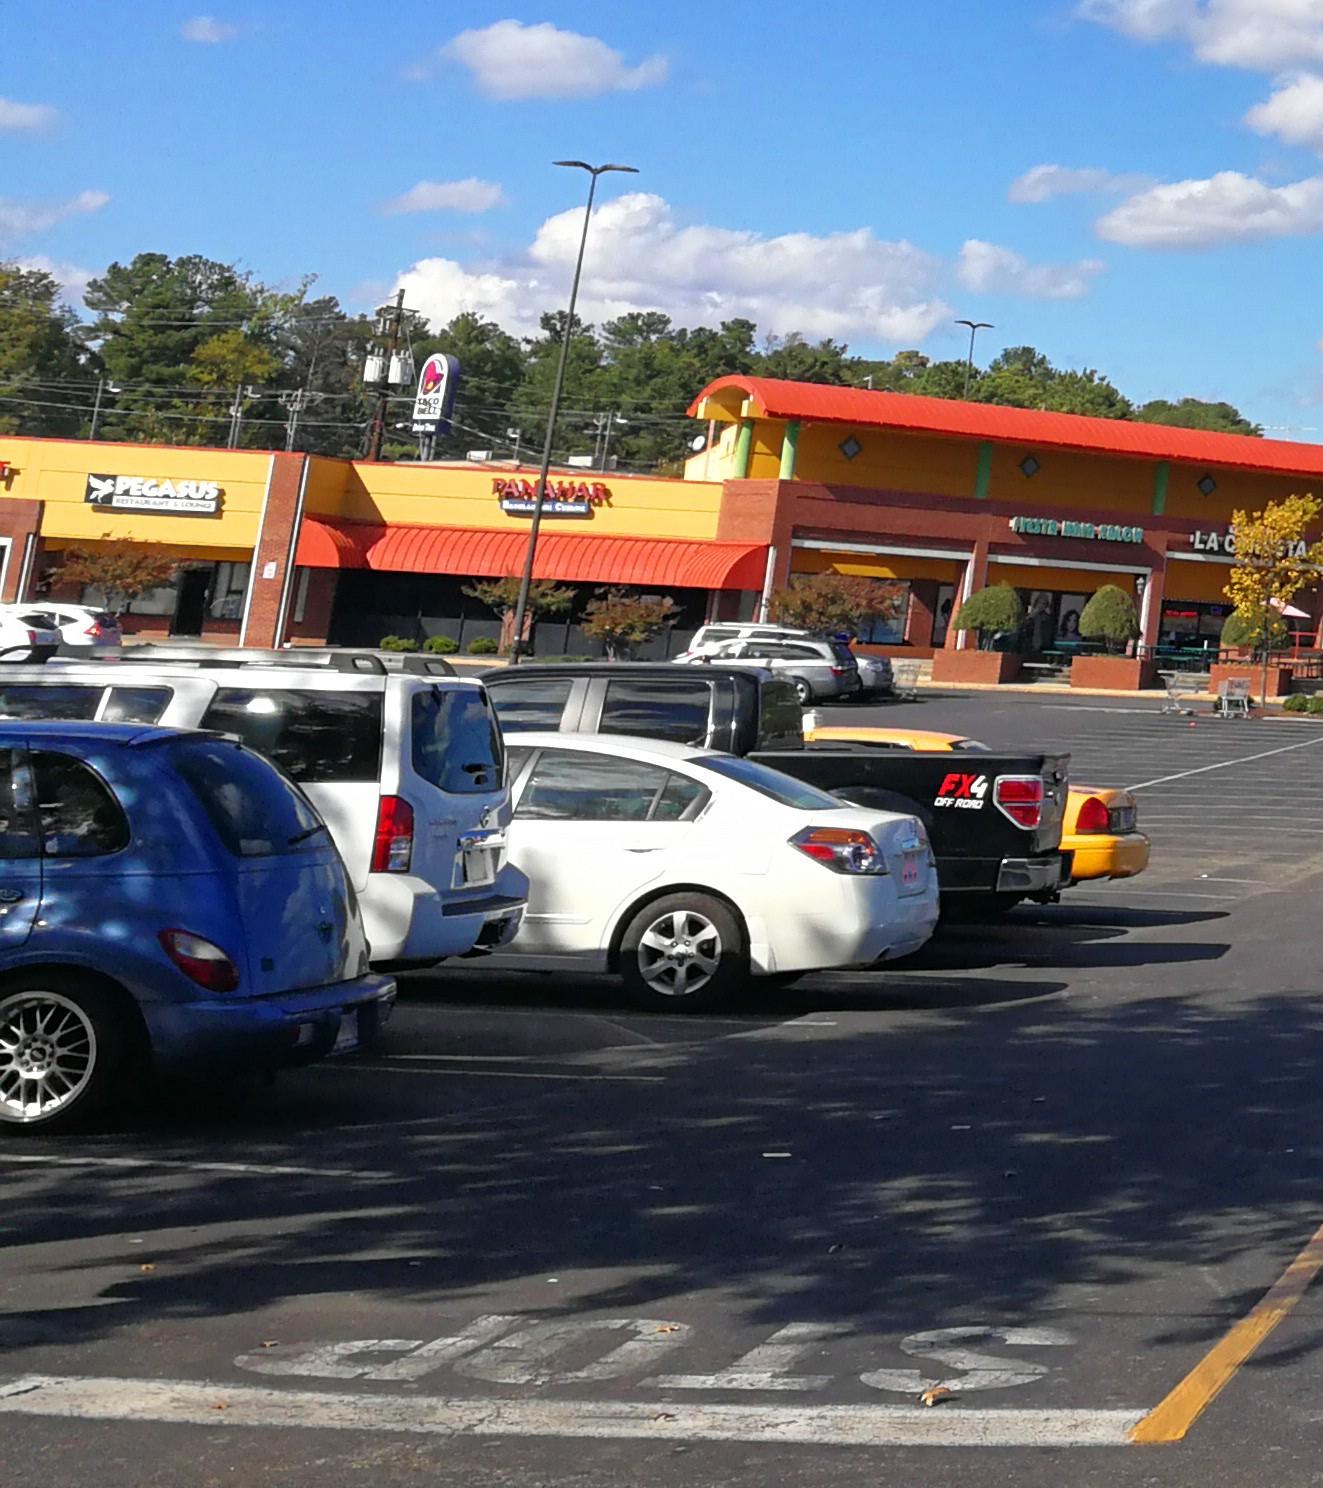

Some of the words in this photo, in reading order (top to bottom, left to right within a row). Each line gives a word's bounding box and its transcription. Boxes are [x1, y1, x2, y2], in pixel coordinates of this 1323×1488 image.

[417, 397, 440, 407] TACO
[115, 475, 219, 500] PEGASUS
[1193, 530, 1219, 551] LA
[938, 773, 988, 798] FX4
[934, 797, 955, 807] OFF
[954, 798, 984, 809] ROAD
[233, 1315, 1078, 1394] STOP
